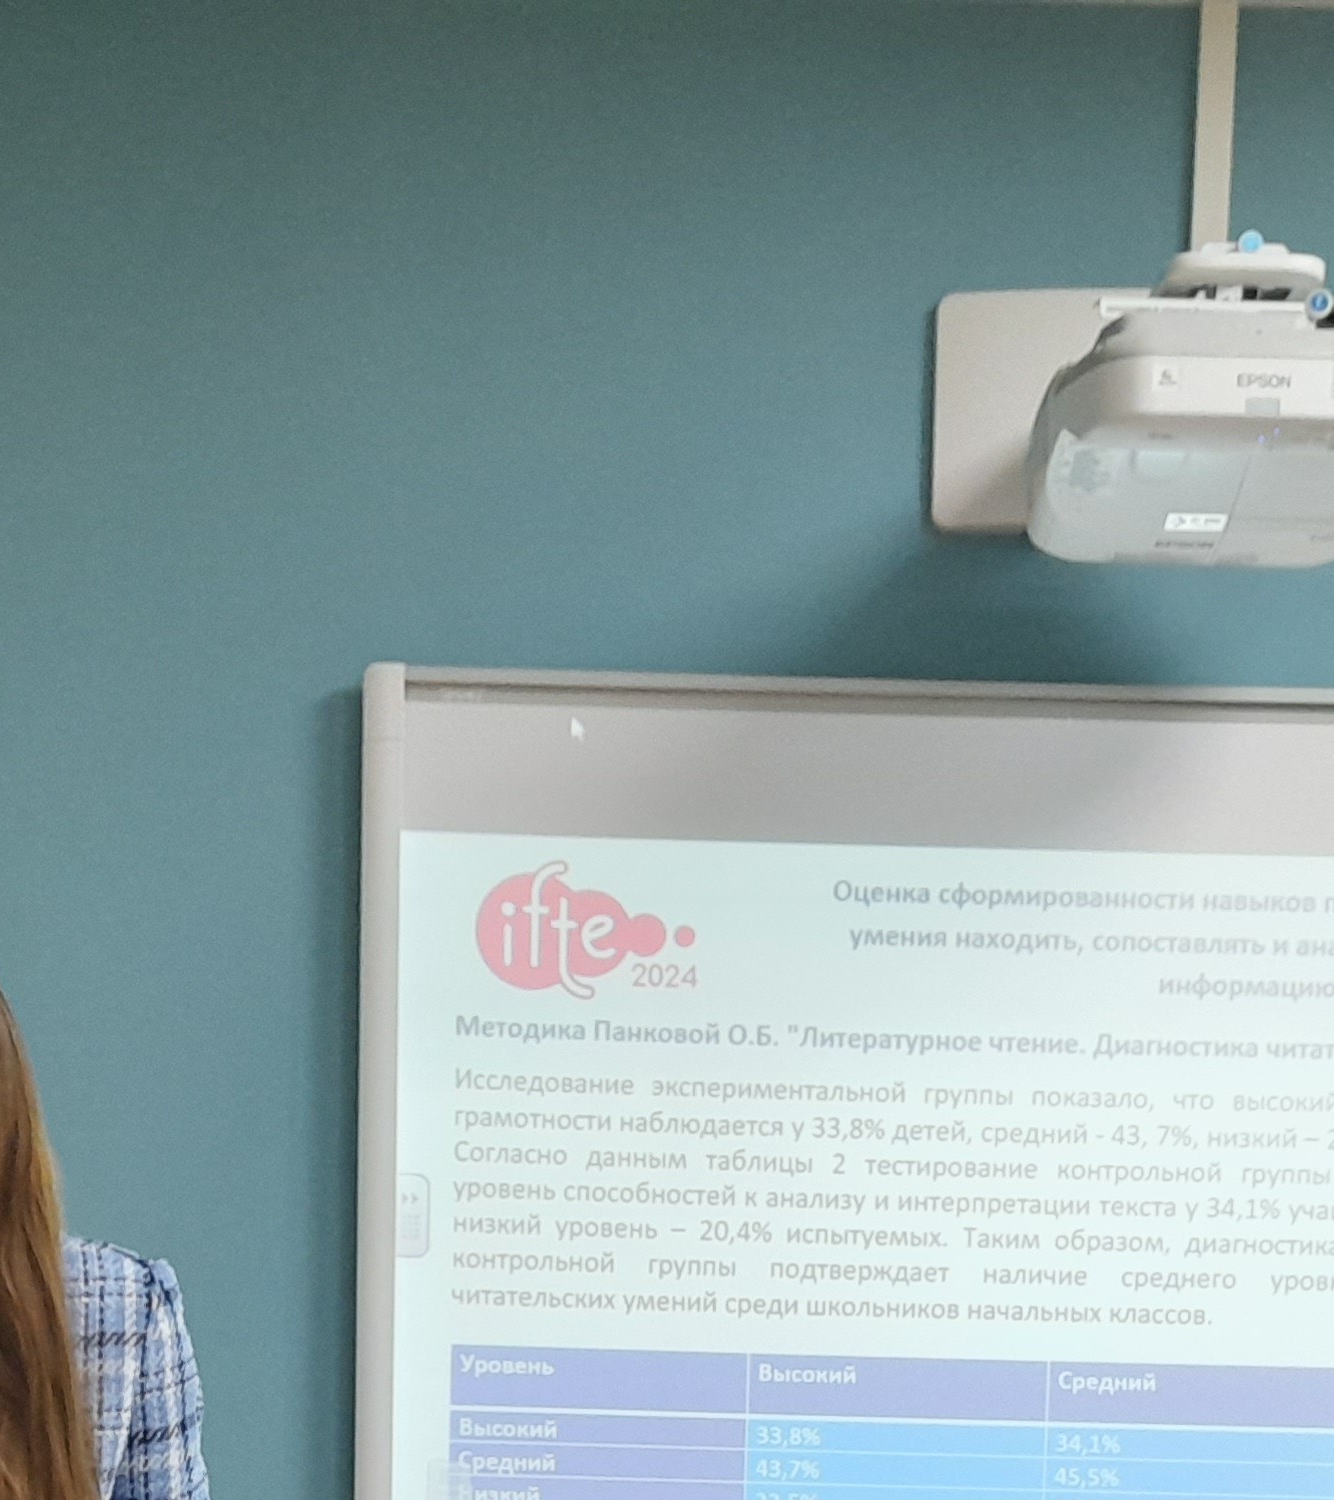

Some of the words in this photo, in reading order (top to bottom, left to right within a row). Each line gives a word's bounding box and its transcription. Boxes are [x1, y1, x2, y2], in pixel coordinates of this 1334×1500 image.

[1237, 373, 1291, 389] EPSON
[833, 879, 931, 909] Оценка
[938, 881, 1194, 912] сформированности
[1203, 892, 1317, 916] навыков
[501, 861, 617, 999] ifte
[849, 928, 947, 951] умения
[955, 931, 1083, 957] находить,
[1092, 934, 1266, 955] сопоставлять
[1272, 939, 1289, 956] и
[631, 963, 698, 989] 2024
[456, 1014, 586, 1045] Методика
[594, 1019, 720, 1045] Панковой
[728, 1023, 779, 1047] О.Б.
[788, 1024, 982, 1056] "Литературное
[989, 1036, 1085, 1055] чтение.
[1092, 1032, 1258, 1061] Диагностика
[455, 1067, 634, 1097] Исследование
[652, 1079, 906, 1104] экспериментальной
[924, 1087, 1013, 1110] группы
[1032, 1090, 1154, 1113] показало,
[1173, 1093, 1214, 1111] что
[455, 1109, 611, 1132] грамотности
[620, 1110, 784, 1140] наблюдается
[791, 1121, 805, 1143] у
[812, 1116, 885, 1142] 33,8%
[891, 1120, 972, 1146] детей,
[981, 1123, 1087, 1149] средний
[1111, 1124, 1147, 1149] 43,
[1158, 1124, 1198, 1150] 7%,
[1207, 1128, 1297, 1149] низкий
[454, 1140, 567, 1166] Согласно
[585, 1150, 687, 1172] данным
[706, 1148, 813, 1178] таблицы
[832, 1152, 845, 1175] 2
[864, 1158, 1038, 1182] тестирование
[1057, 1162, 1221, 1186] контрольной
[1242, 1167, 1330, 1189] группы
[453, 1181, 556, 1203] уровень
[563, 1180, 736, 1207] способностей
[745, 1191, 757, 1208] к
[765, 1191, 866, 1215] анализу
[875, 1194, 889, 1211] и
[898, 1194, 1090, 1220] интерпретации
[1099, 1199, 1176, 1218] текста
[1185, 1201, 1199, 1223] у
[1207, 1196, 1281, 1222] 34,1%
[454, 1213, 541, 1236] низкий
[555, 1220, 658, 1241] уровень
[700, 1219, 772, 1245] 20,4%
[787, 1227, 948, 1251] испытуемых.
[963, 1226, 1040, 1250] Таким
[1055, 1228, 1170, 1256] образом,
[453, 1251, 614, 1275] контрольной
[648, 1257, 736, 1281] группы
[770, 1261, 950, 1287] подтверждает
[983, 1267, 1087, 1287] наличие
[1121, 1270, 1237, 1293] среднего
[451, 1286, 615, 1312] читательских
[623, 1291, 717, 1316] умений
[725, 1296, 798, 1320] среди
[807, 1299, 959, 1321] школьников
[968, 1302, 1101, 1326] начальных
[1110, 1307, 1212, 1326] классов.
[462, 1356, 554, 1378] Уровень
[759, 1362, 857, 1385] Высокий
[1058, 1371, 1156, 1396] Средний
[461, 1418, 557, 1439] Высокий
[757, 1425, 821, 1448] 33,8%
[1056, 1433, 1121, 1455] 34,1%
[460, 1452, 555, 1474] Средний
[755, 1459, 820, 1481] 43,7%
[1054, 1467, 1120, 1488] 45,5%
